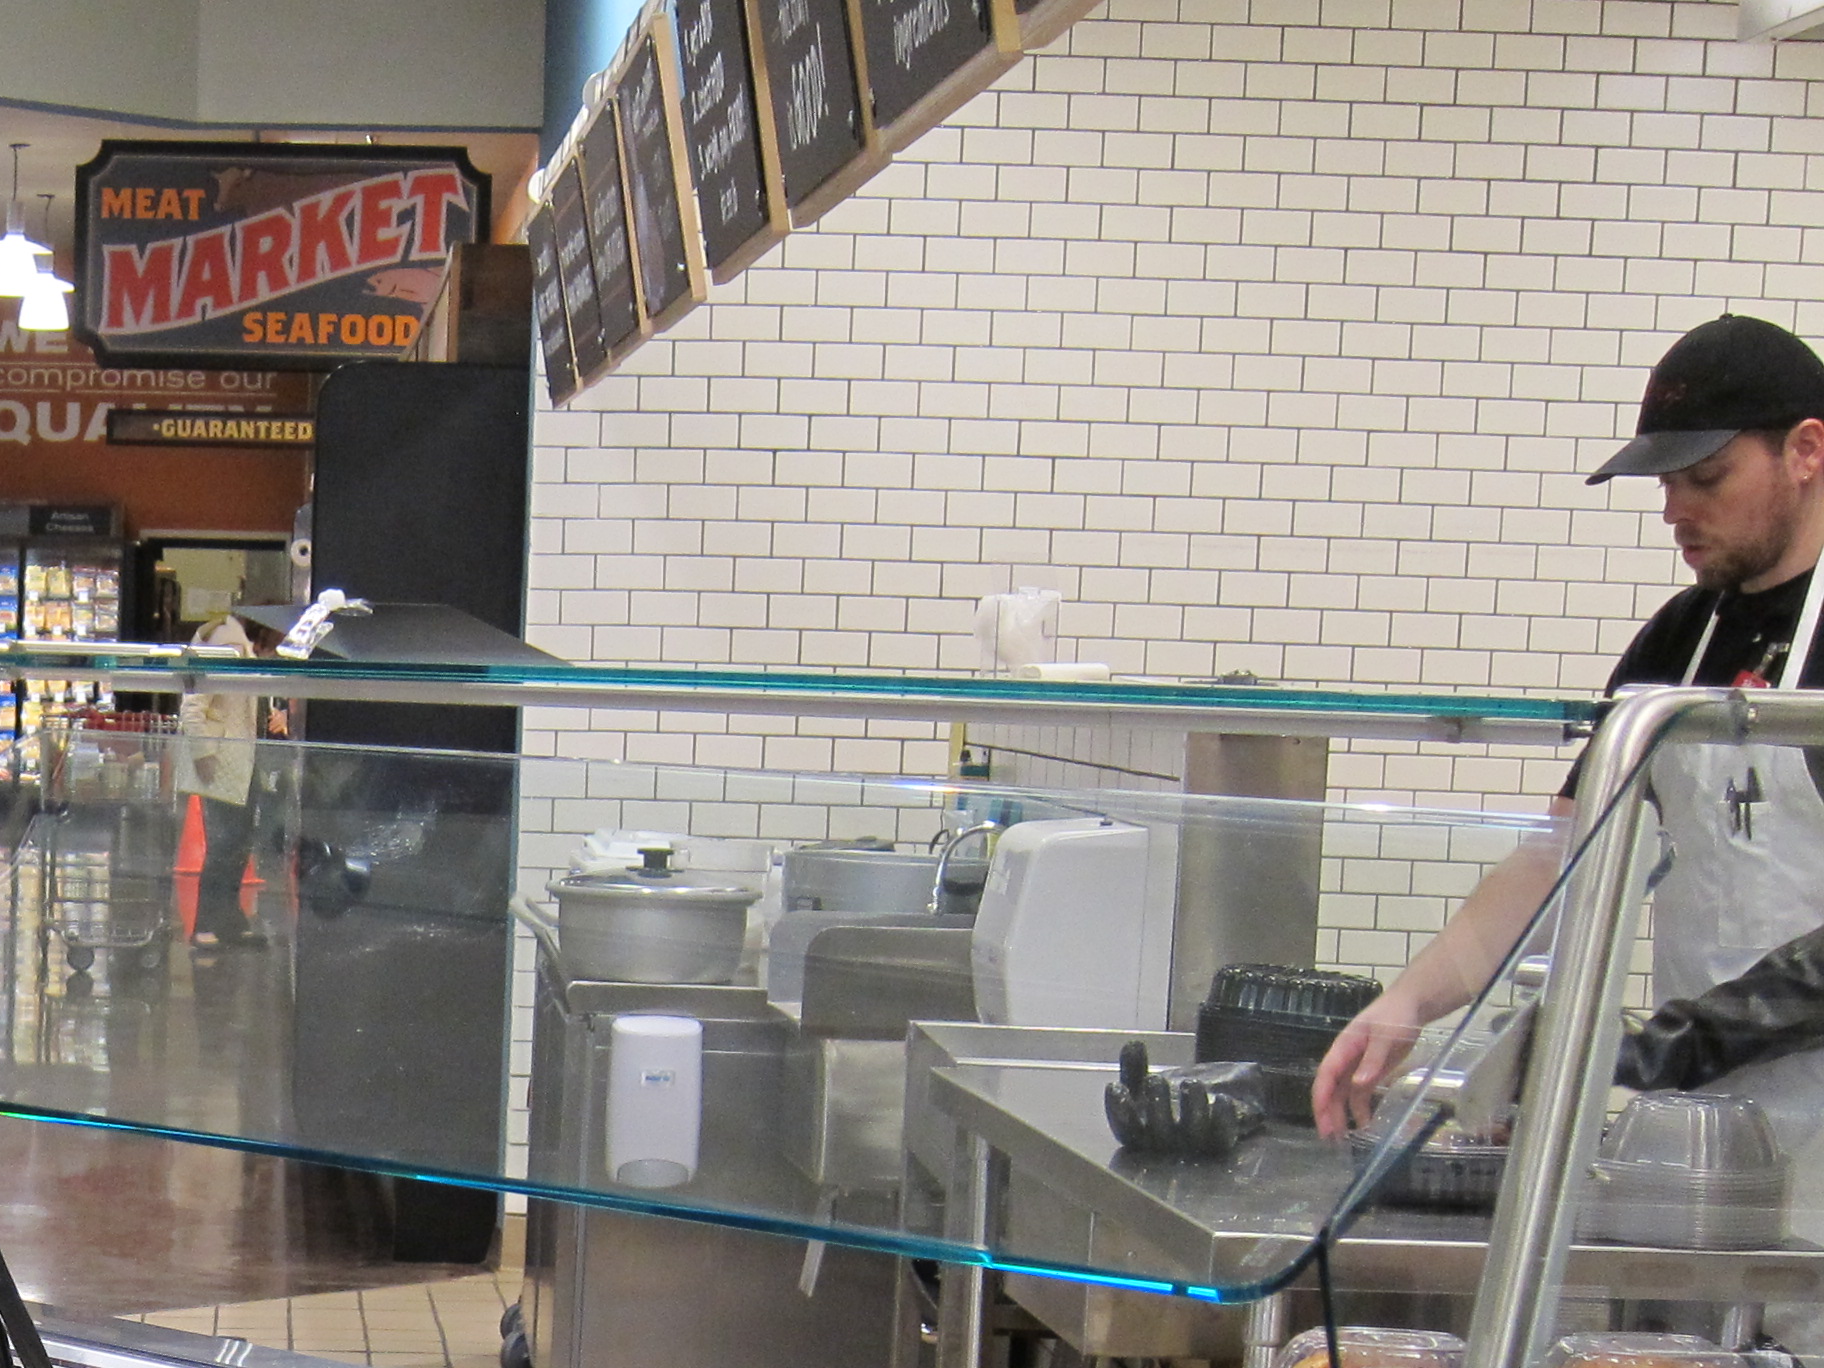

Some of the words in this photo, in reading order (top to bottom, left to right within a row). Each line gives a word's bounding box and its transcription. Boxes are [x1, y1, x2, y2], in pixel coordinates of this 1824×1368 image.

[100, 187, 206, 220] MEAT
[101, 168, 471, 336] MARKET
[242, 312, 420, 347] SEAFOOD
[219, 370, 276, 389] our
